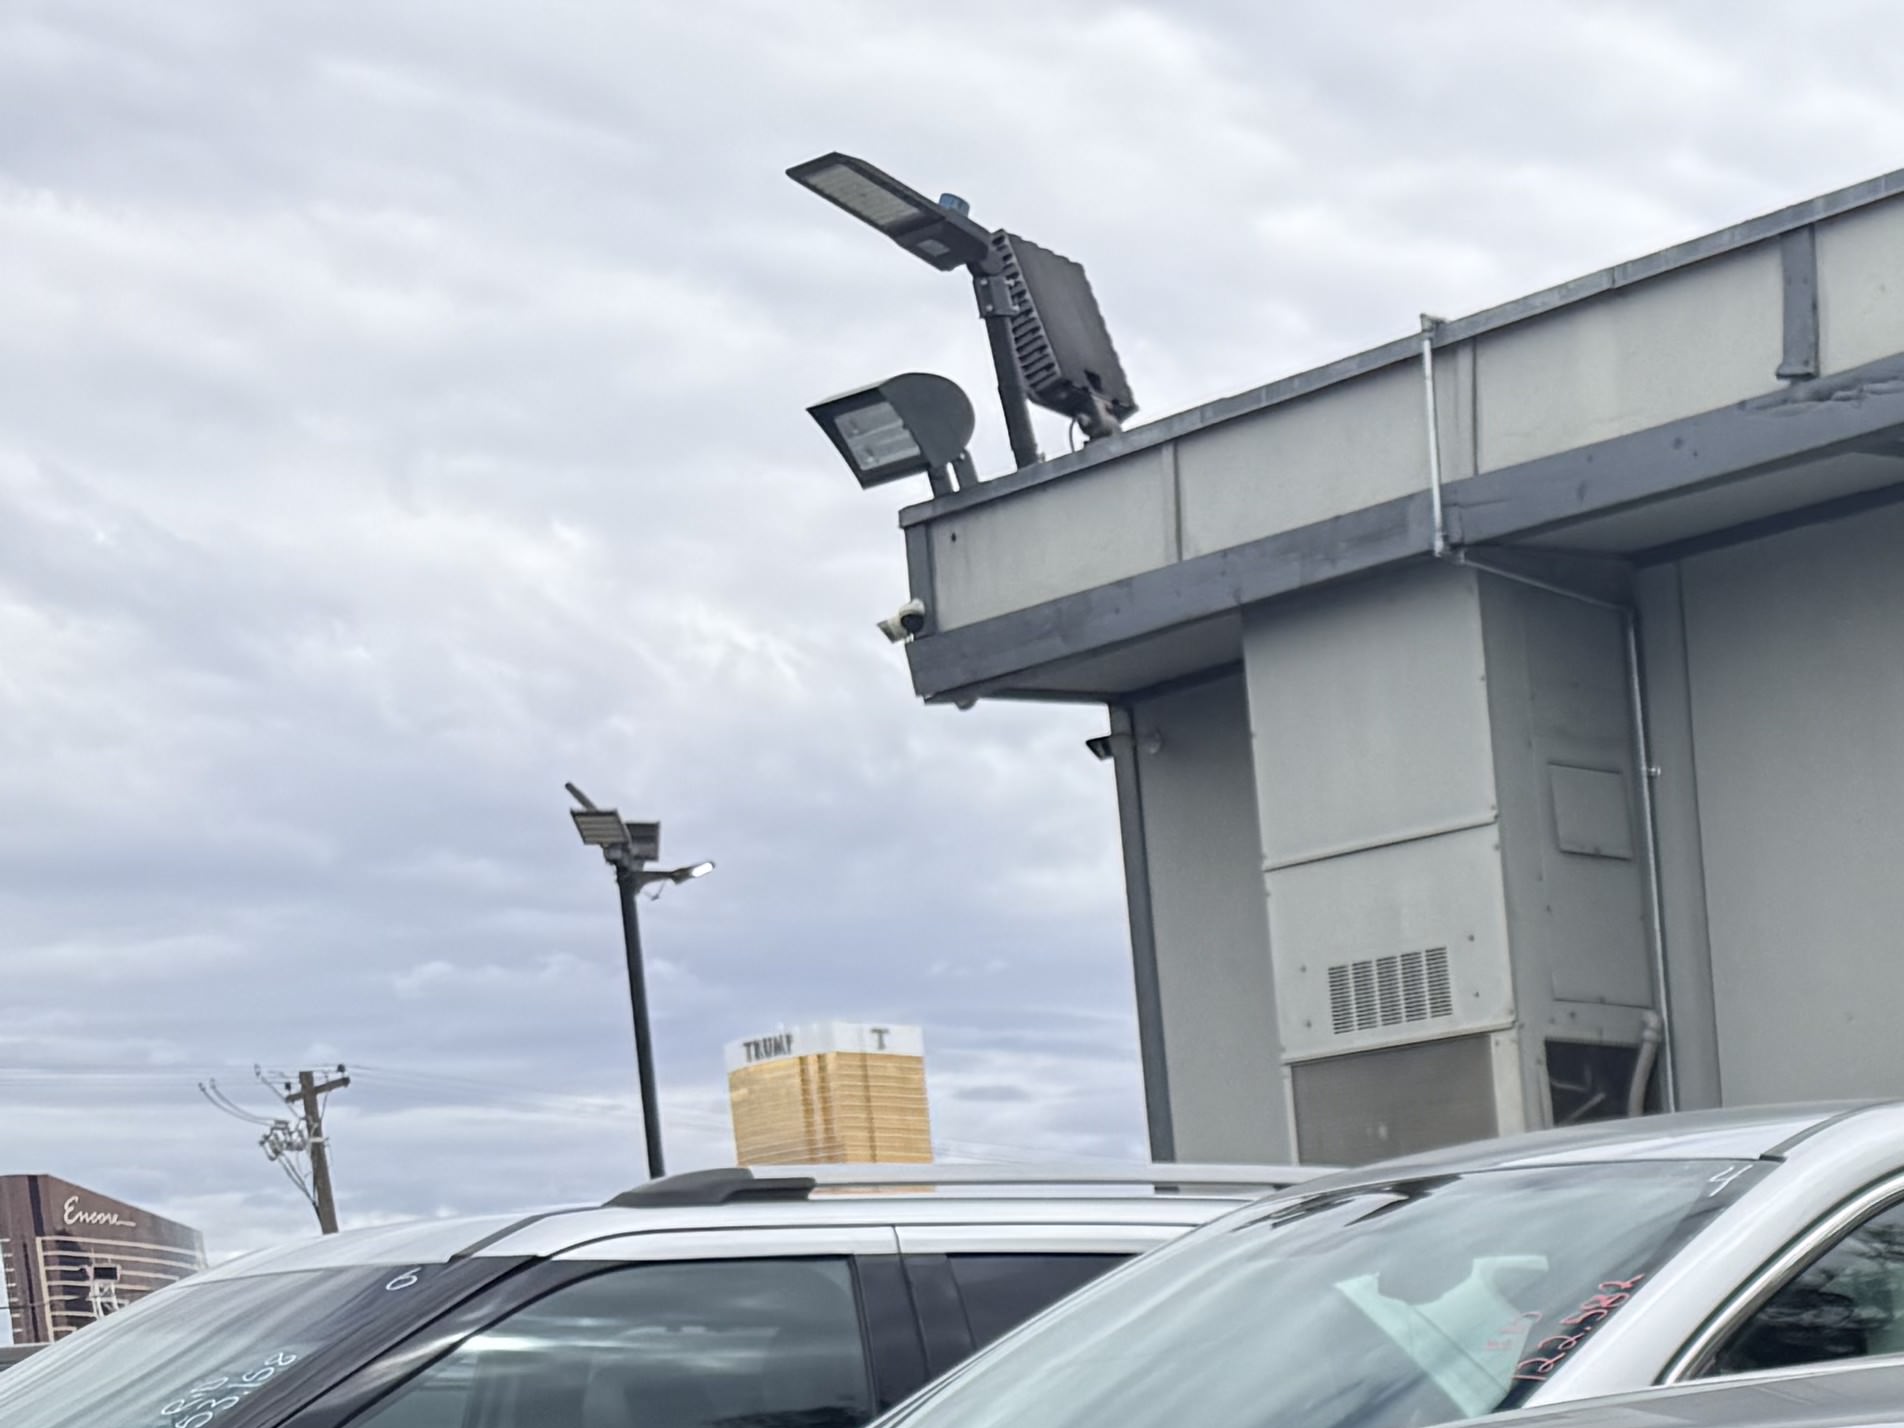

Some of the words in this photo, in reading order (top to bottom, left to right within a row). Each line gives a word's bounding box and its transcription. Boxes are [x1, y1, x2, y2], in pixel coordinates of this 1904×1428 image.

[742, 1032, 794, 1064] TRUMP
[1707, 1164, 1754, 1198] 4
[63, 1195, 137, 1227] Encore
